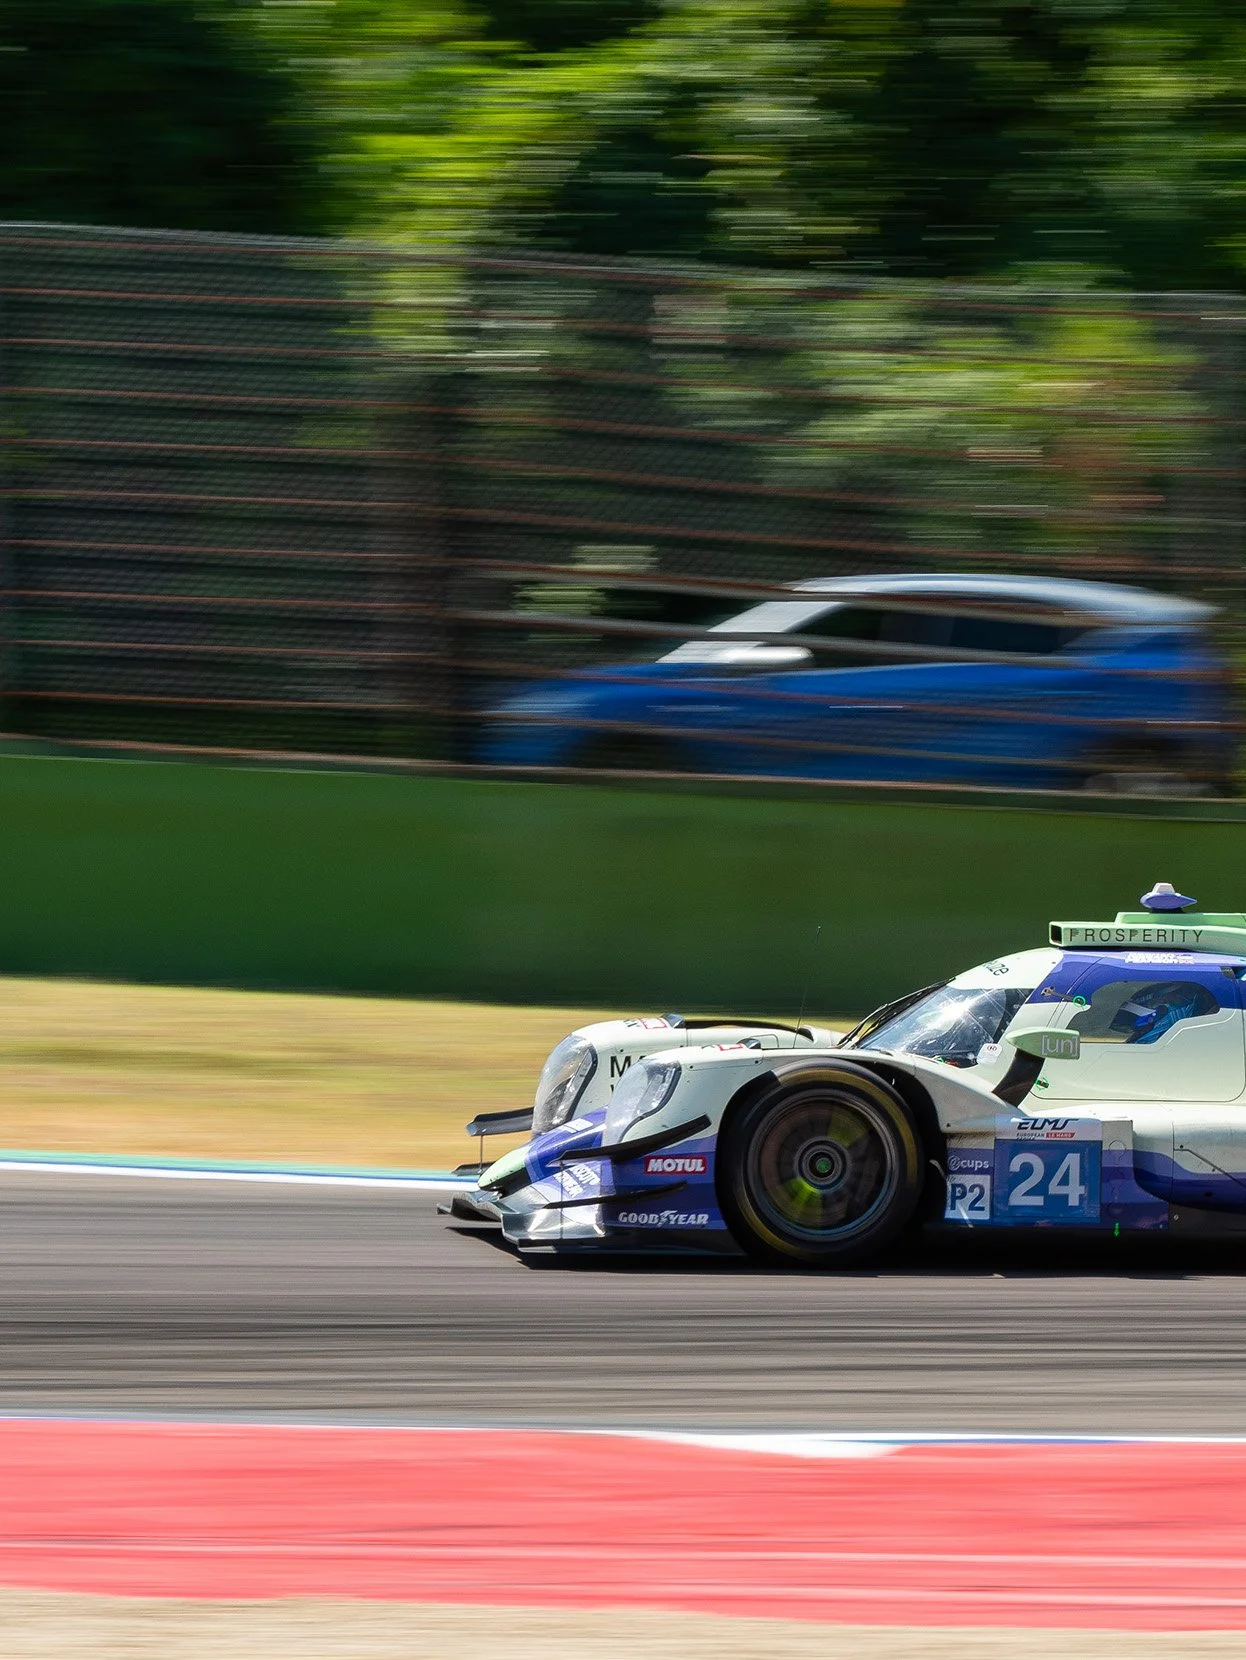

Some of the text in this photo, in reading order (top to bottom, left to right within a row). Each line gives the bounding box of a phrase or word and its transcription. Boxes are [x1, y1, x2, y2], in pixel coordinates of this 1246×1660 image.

[1069, 928, 1204, 943] PROSPERITY
[647, 1158, 705, 1172] MOTUL
[1008, 1152, 1086, 1207] 24
[618, 1210, 709, 1227] GOODYEAR
